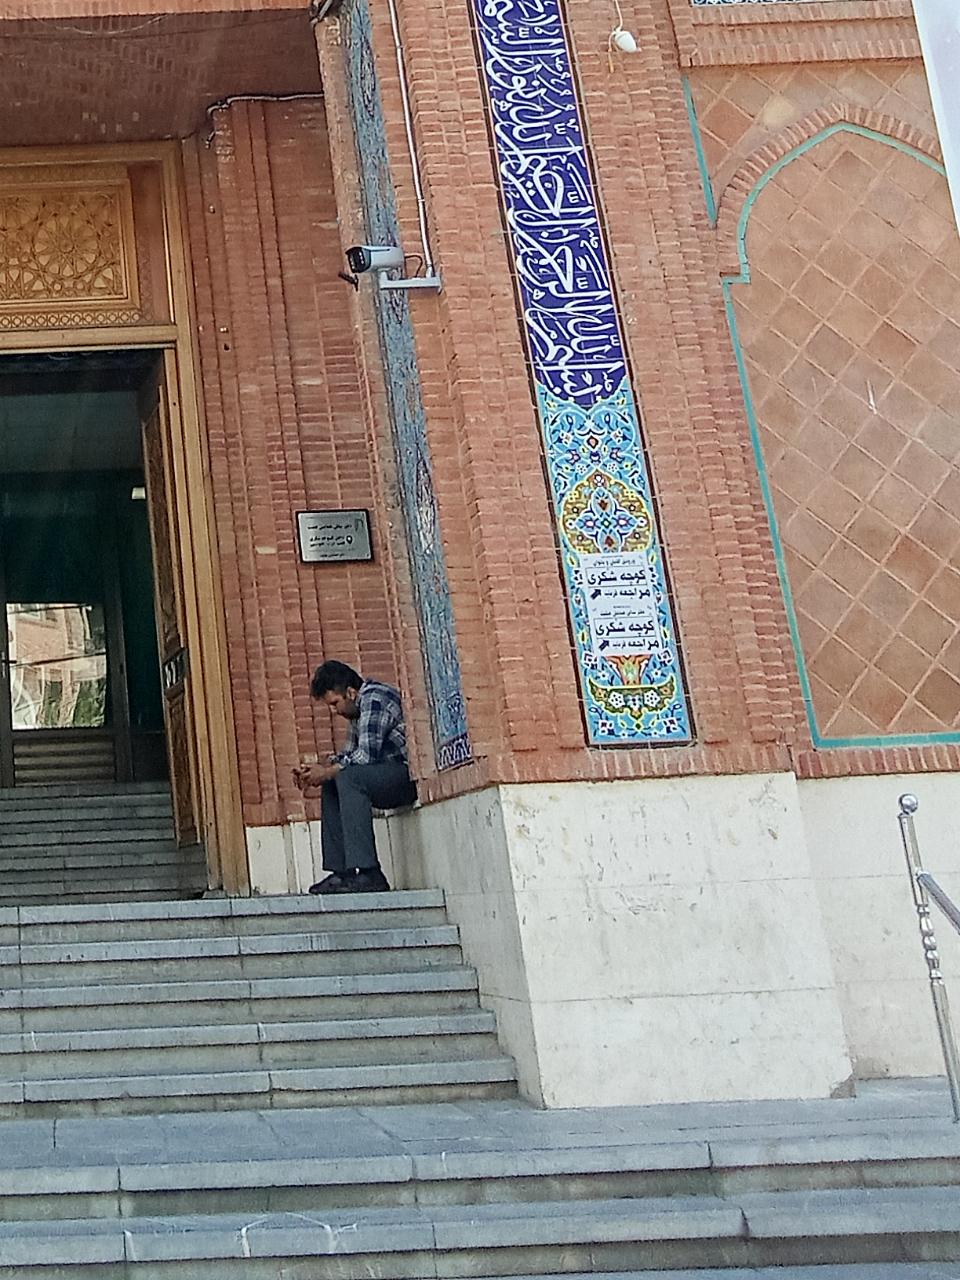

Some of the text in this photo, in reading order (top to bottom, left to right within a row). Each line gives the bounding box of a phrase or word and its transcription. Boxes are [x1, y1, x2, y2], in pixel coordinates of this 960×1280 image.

[589, 571, 645, 585] کوچه شکری
[595, 621, 653, 635] کوچه شکری
